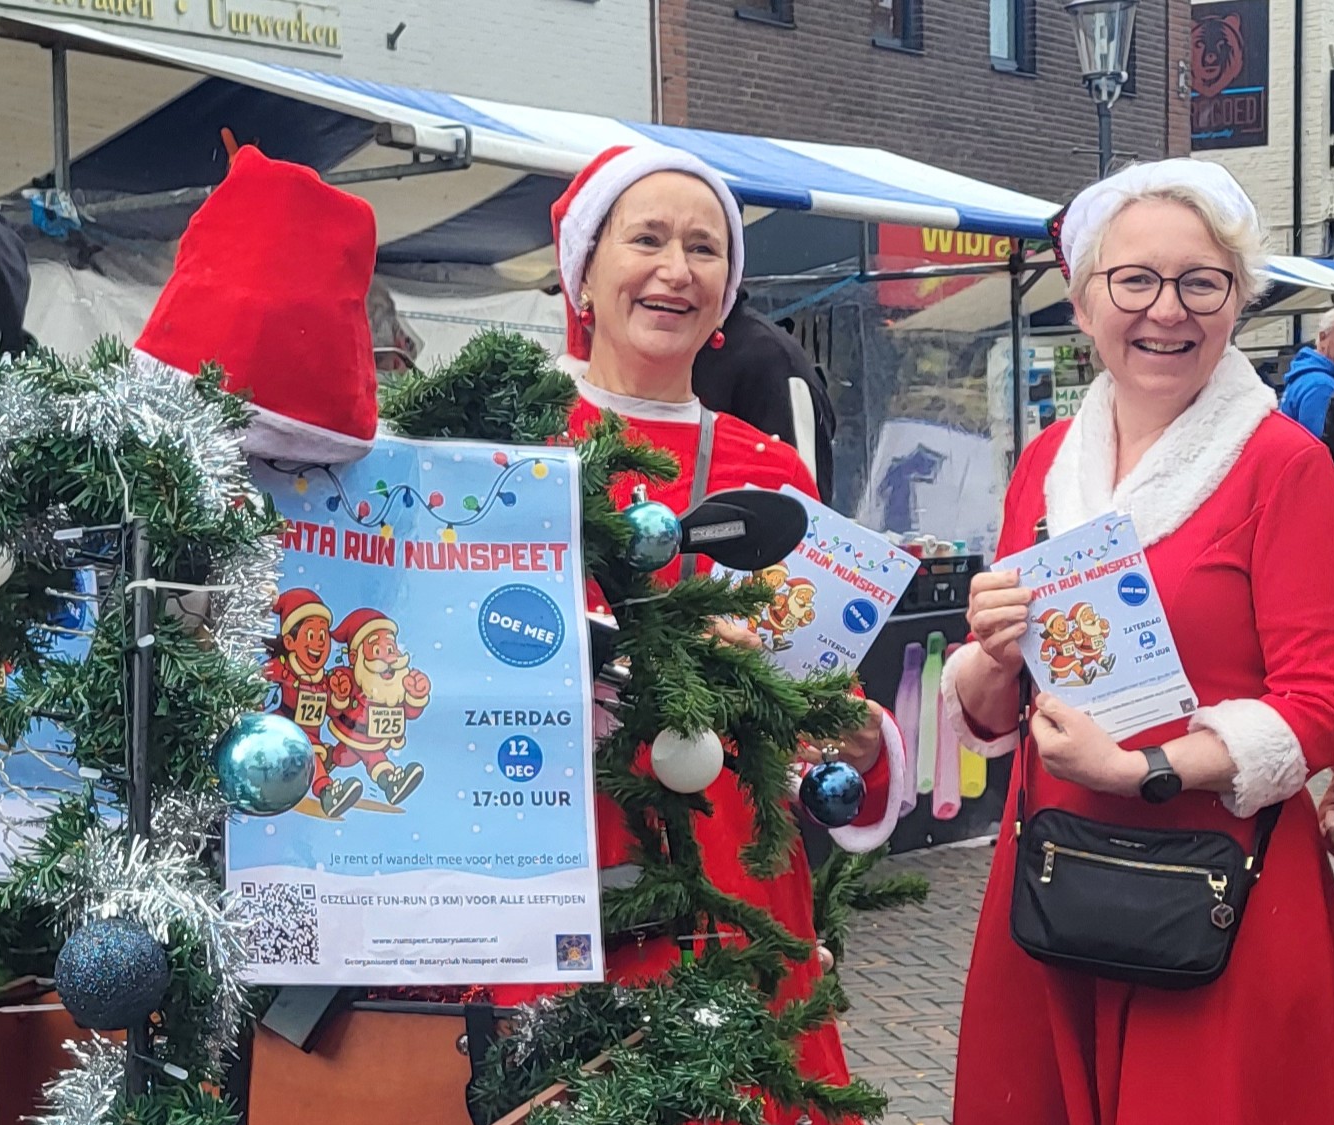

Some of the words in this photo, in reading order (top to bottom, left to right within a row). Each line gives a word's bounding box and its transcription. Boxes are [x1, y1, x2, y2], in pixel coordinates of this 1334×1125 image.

[209, 0, 342, 48] Uurwerken
[277, 519, 335, 557] NTA
[344, 530, 395, 567] RUN
[404, 540, 568, 572] NUNSPEET
[806, 548, 832, 571] RUN
[832, 559, 897, 606] NUNSPEET
[1058, 573, 1082, 591] RUN
[1084, 552, 1144, 582] NUNSPEET
[488, 610, 521, 633] DOE
[523, 622, 556, 645] MEE
[300, 703, 323, 722] 124
[465, 710, 572, 726] ZATERDAG
[373, 718, 402, 735] 125
[509, 740, 529, 756] 12
[505, 765, 535, 777] DEC
[473, 791, 524, 807] 17:00
[531, 790, 571, 807] UUR
[330, 853, 341, 866] Je
[344, 854, 368, 865] rent
[371, 852, 384, 865] of
[386, 852, 435, 866] wandelt
[437, 855, 463, 865] mee
[465, 855, 493, 865] voor
[495, 853, 516, 866] het
[517, 853, 554, 867] goede
[556, 852, 583, 865] doel
[320, 894, 375, 906] GEZELLIGE
[377, 894, 428, 906] FUN-RUN
[442, 894, 464, 907] KM)
[466, 894, 498, 906] VOOR
[499, 894, 525, 906] ALLE
[528, 894, 586, 906] LEEFTIJDEN
